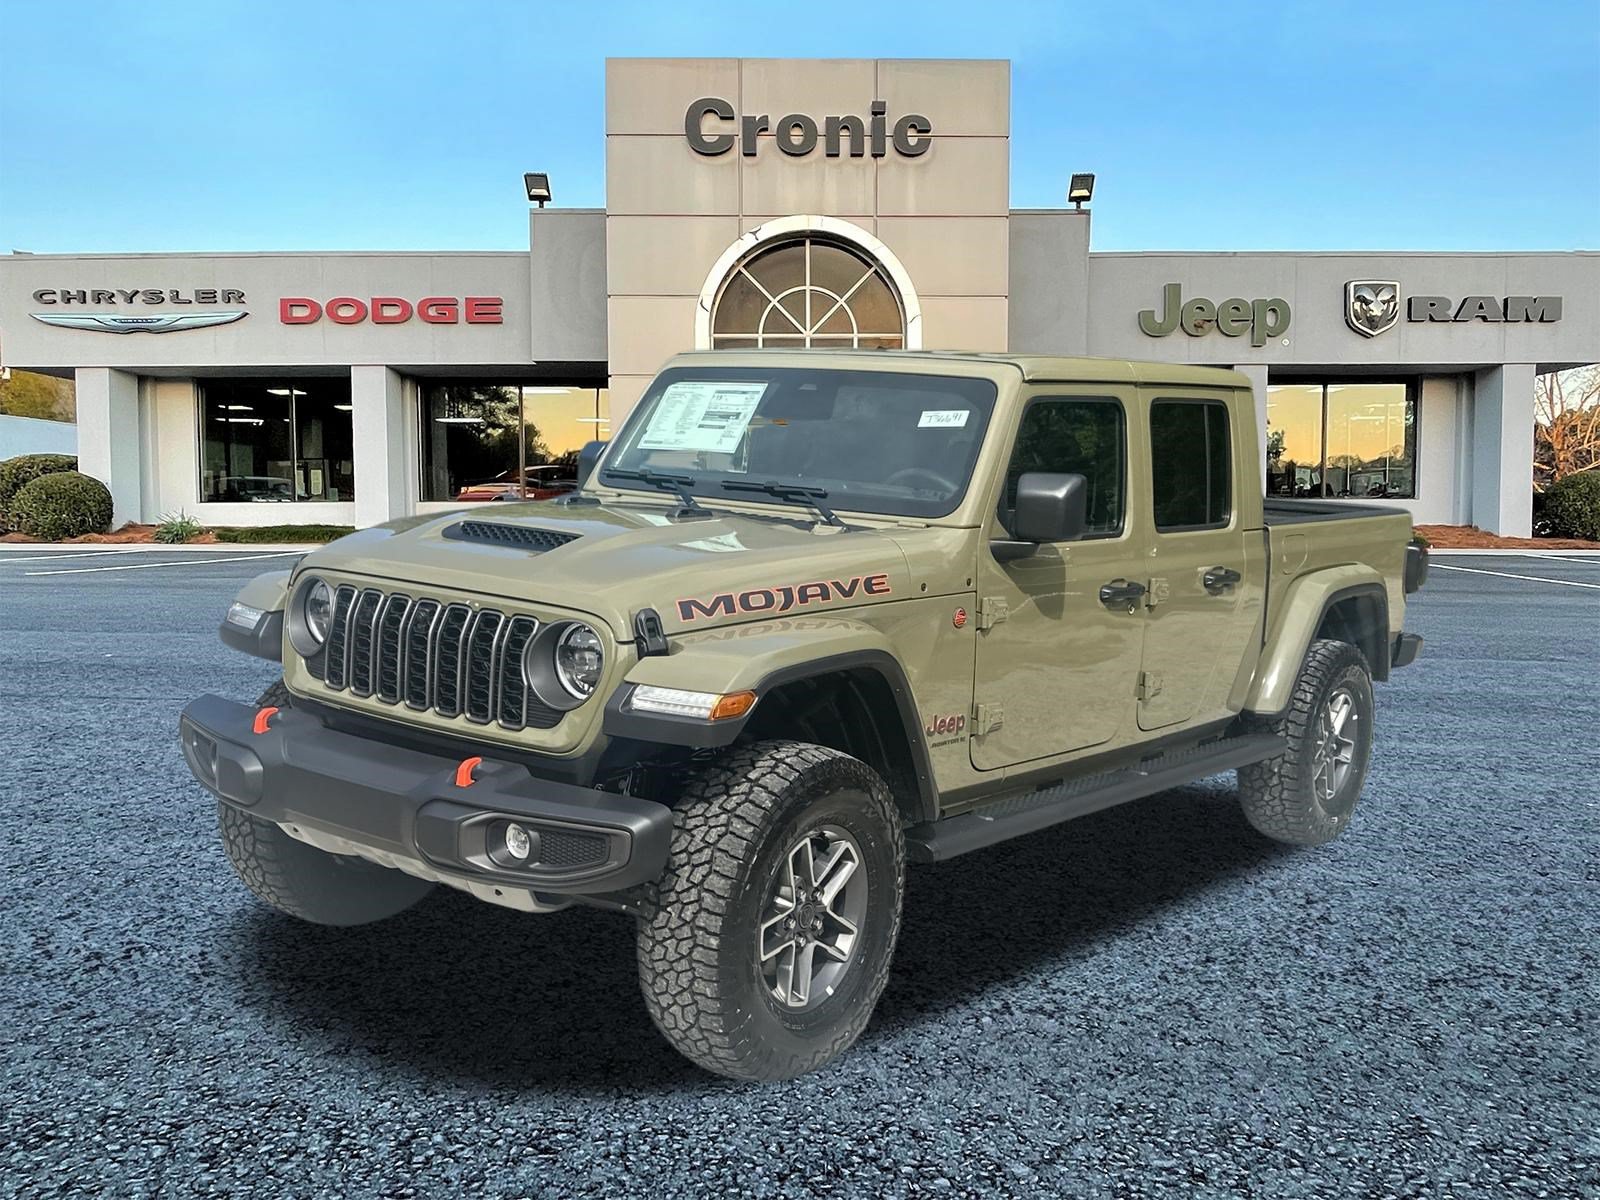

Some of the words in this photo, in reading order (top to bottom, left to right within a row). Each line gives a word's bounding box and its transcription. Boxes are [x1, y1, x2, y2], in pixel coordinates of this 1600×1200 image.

[684, 97, 932, 157] Cronic
[32, 288, 247, 305] CHRYSLER
[1407, 296, 1563, 323] RAM
[279, 297, 504, 325] DODGE
[1138, 282, 1292, 347] Jeep
[677, 574, 892, 623] MOJAVE
[926, 714, 965, 736] Jeep
